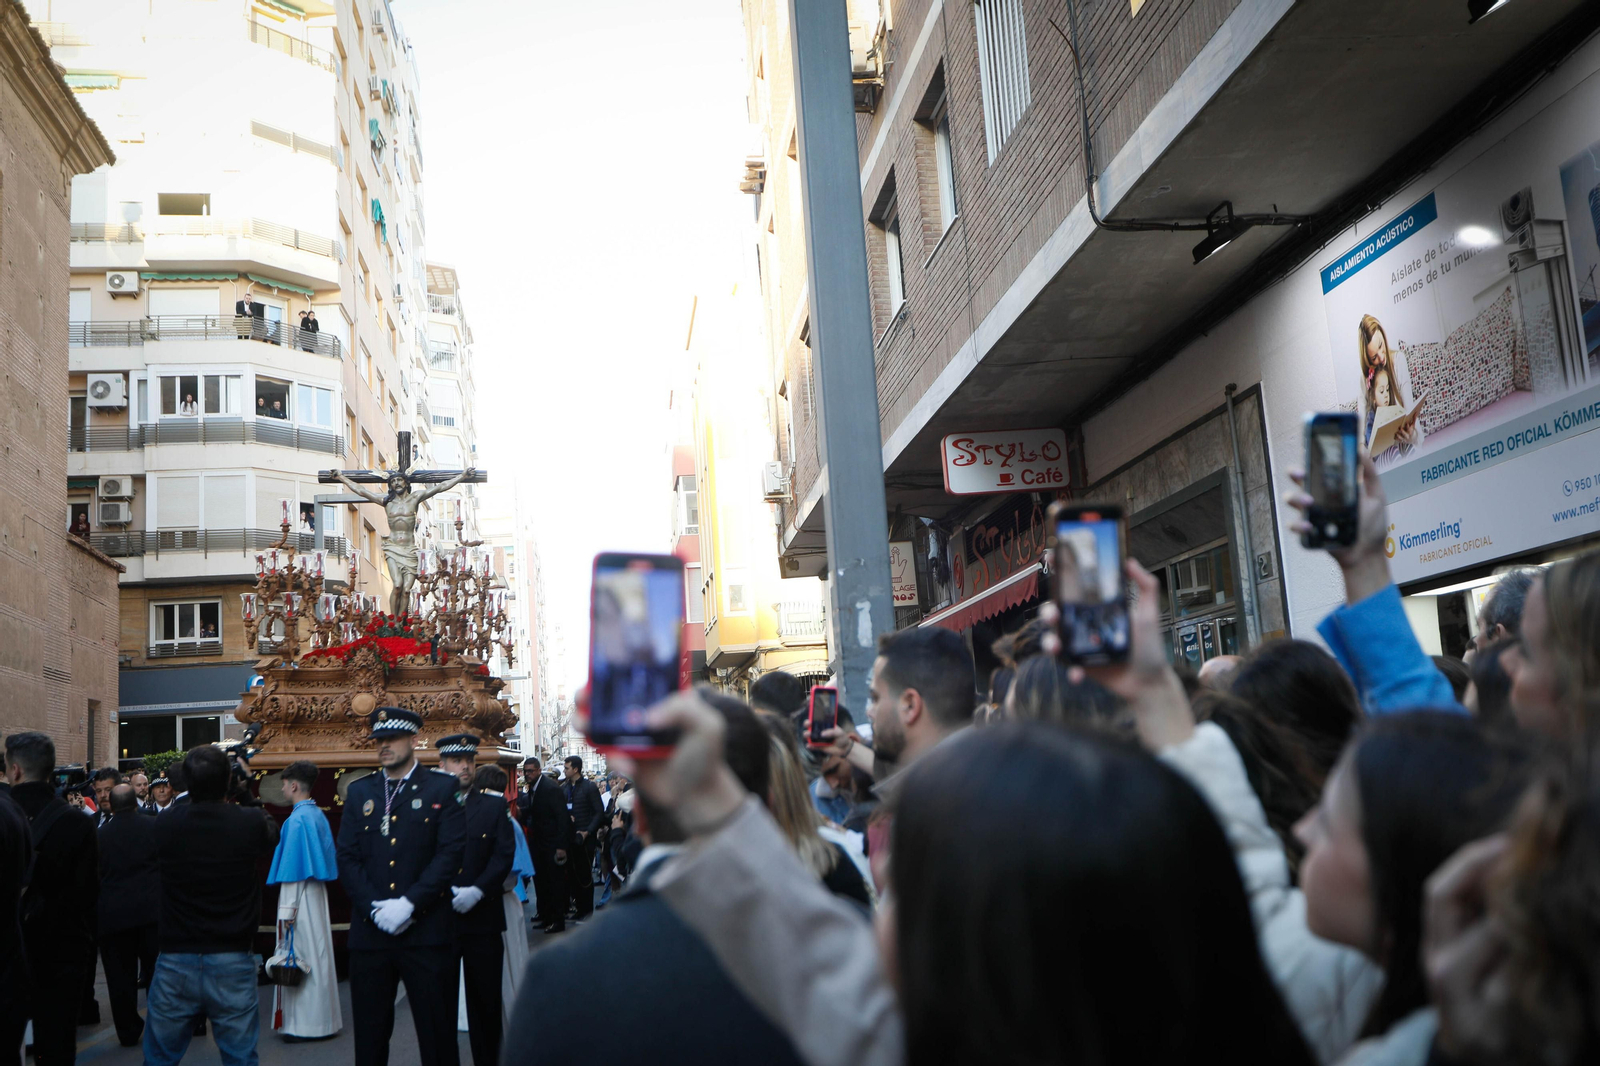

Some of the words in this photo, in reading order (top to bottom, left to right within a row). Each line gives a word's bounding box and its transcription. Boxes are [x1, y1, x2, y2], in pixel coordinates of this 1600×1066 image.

[1330, 243, 1375, 282] AISLAMIENTO
[1376, 215, 1414, 250] ACÚSTICO
[1391, 258, 1422, 285] Aíslate
[1424, 249, 1437, 264] de
[1393, 278, 1424, 304] menos
[1426, 270, 1438, 284] de
[1440, 261, 1451, 275] tu
[1421, 449, 1480, 484] FABRICANTE
[1482, 440, 1504, 461] RED
[1507, 422, 1551, 451] OFICIAL
[1021, 466, 1063, 485] Café
[1574, 476, 1592, 493] 950
[1399, 521, 1461, 551] Kömmerling
[1419, 543, 1462, 564] FABRICANTE
[1463, 535, 1493, 553] OFICIAL
[1258, 555, 1269, 577] 2
